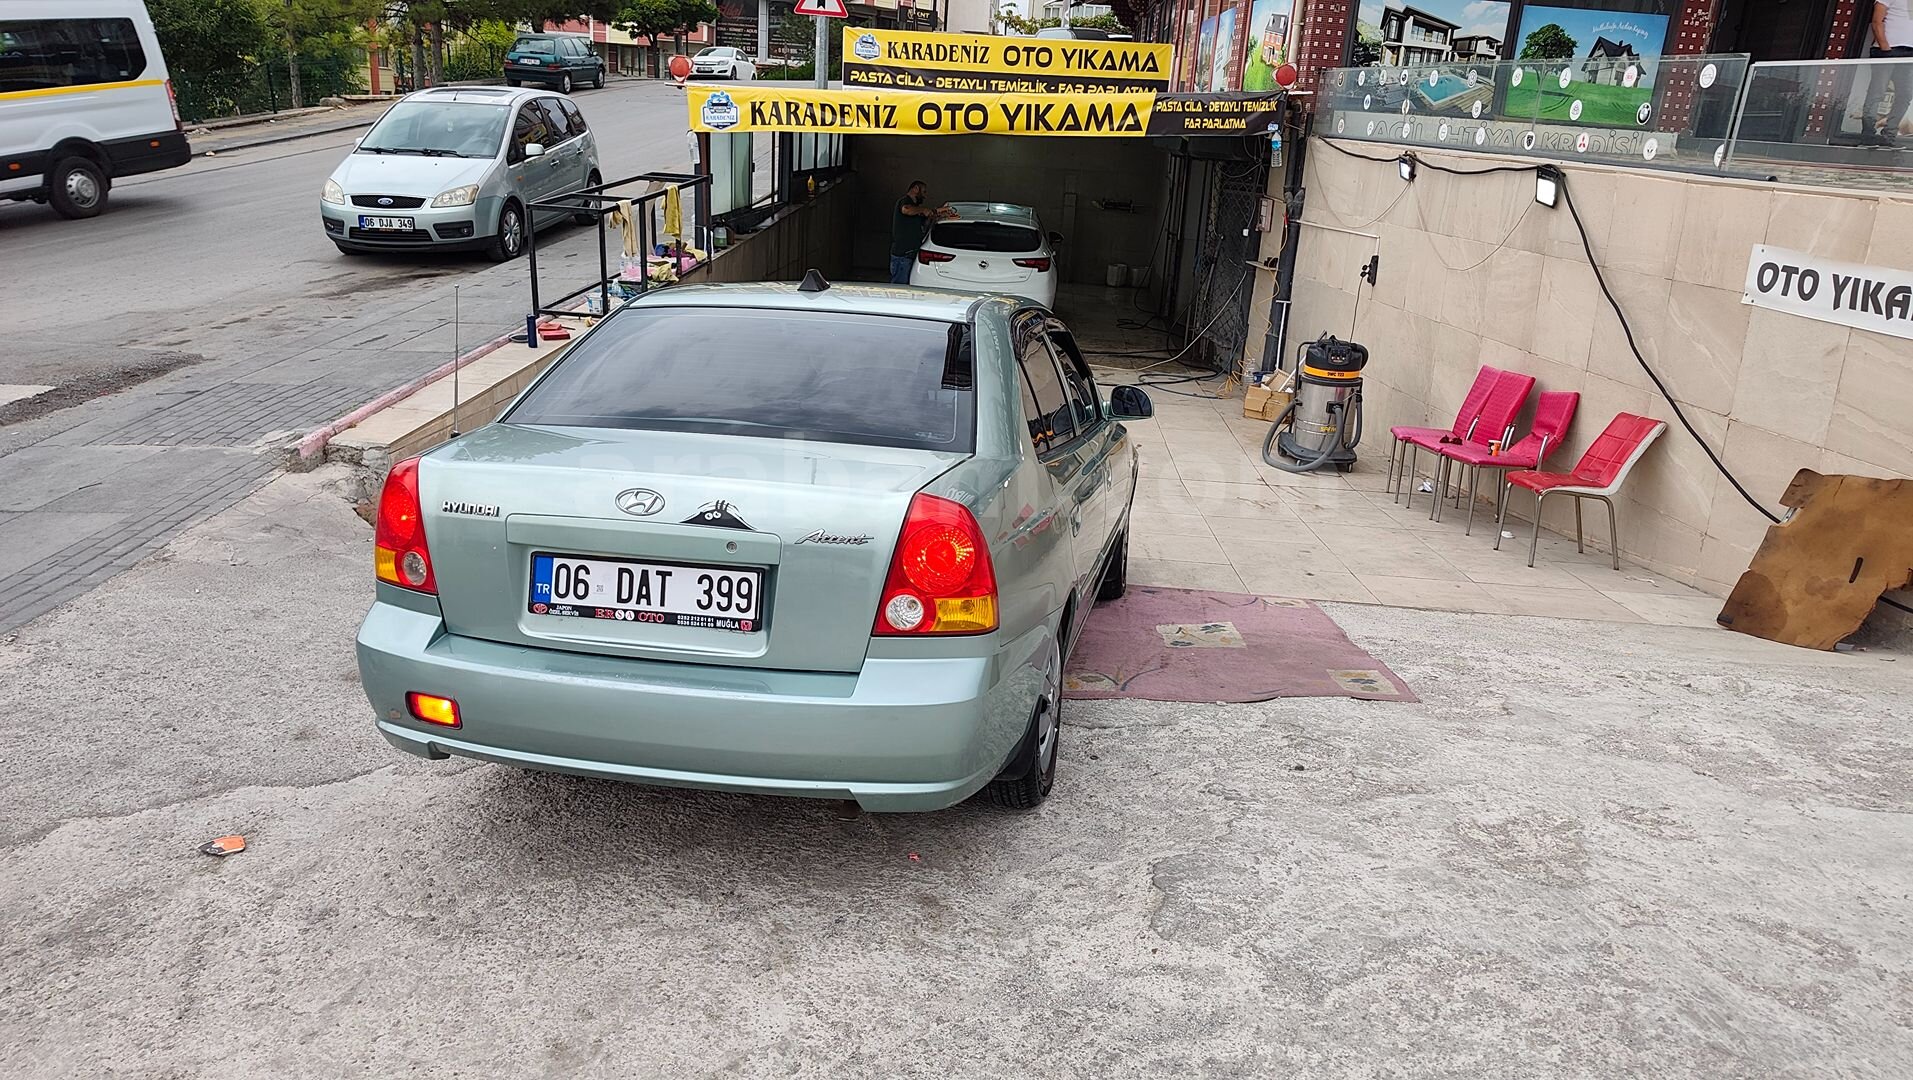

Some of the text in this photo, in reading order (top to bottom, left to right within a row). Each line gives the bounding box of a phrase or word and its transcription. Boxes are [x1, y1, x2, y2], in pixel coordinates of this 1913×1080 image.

[887, 39, 1160, 73] KARADENİZ OTO YIKAMA
[850, 70, 893, 85] PASTA
[896, 72, 925, 87] CİLA
[936, 77, 987, 90] DETAYLI
[990, 78, 1048, 93] TEMİZLİK
[1058, 83, 1085, 94] FAR
[750, 95, 1144, 132] KARADENİZ OTO YIKAMA
[1156, 101, 1182, 112] PASTA
[1184, 98, 1203, 112] CİLA
[1208, 101, 1241, 112] DETAYLI
[1242, 98, 1278, 112] TEMİZLİK
[1184, 117, 1247, 129] FAR PARLATMA
[1541, 129, 1640, 155] KRDİSİ
[364, 217, 413, 228] 06 DJA 349
[1756, 261, 1913, 321] OTO YIKA
[442, 500, 501, 517] HYUNDAI
[795, 528, 875, 546] Accent
[536, 562, 754, 614] TR 06 DAT 399
[638, 611, 665, 623] OTO
[716, 619, 739, 629] MUĞLA
